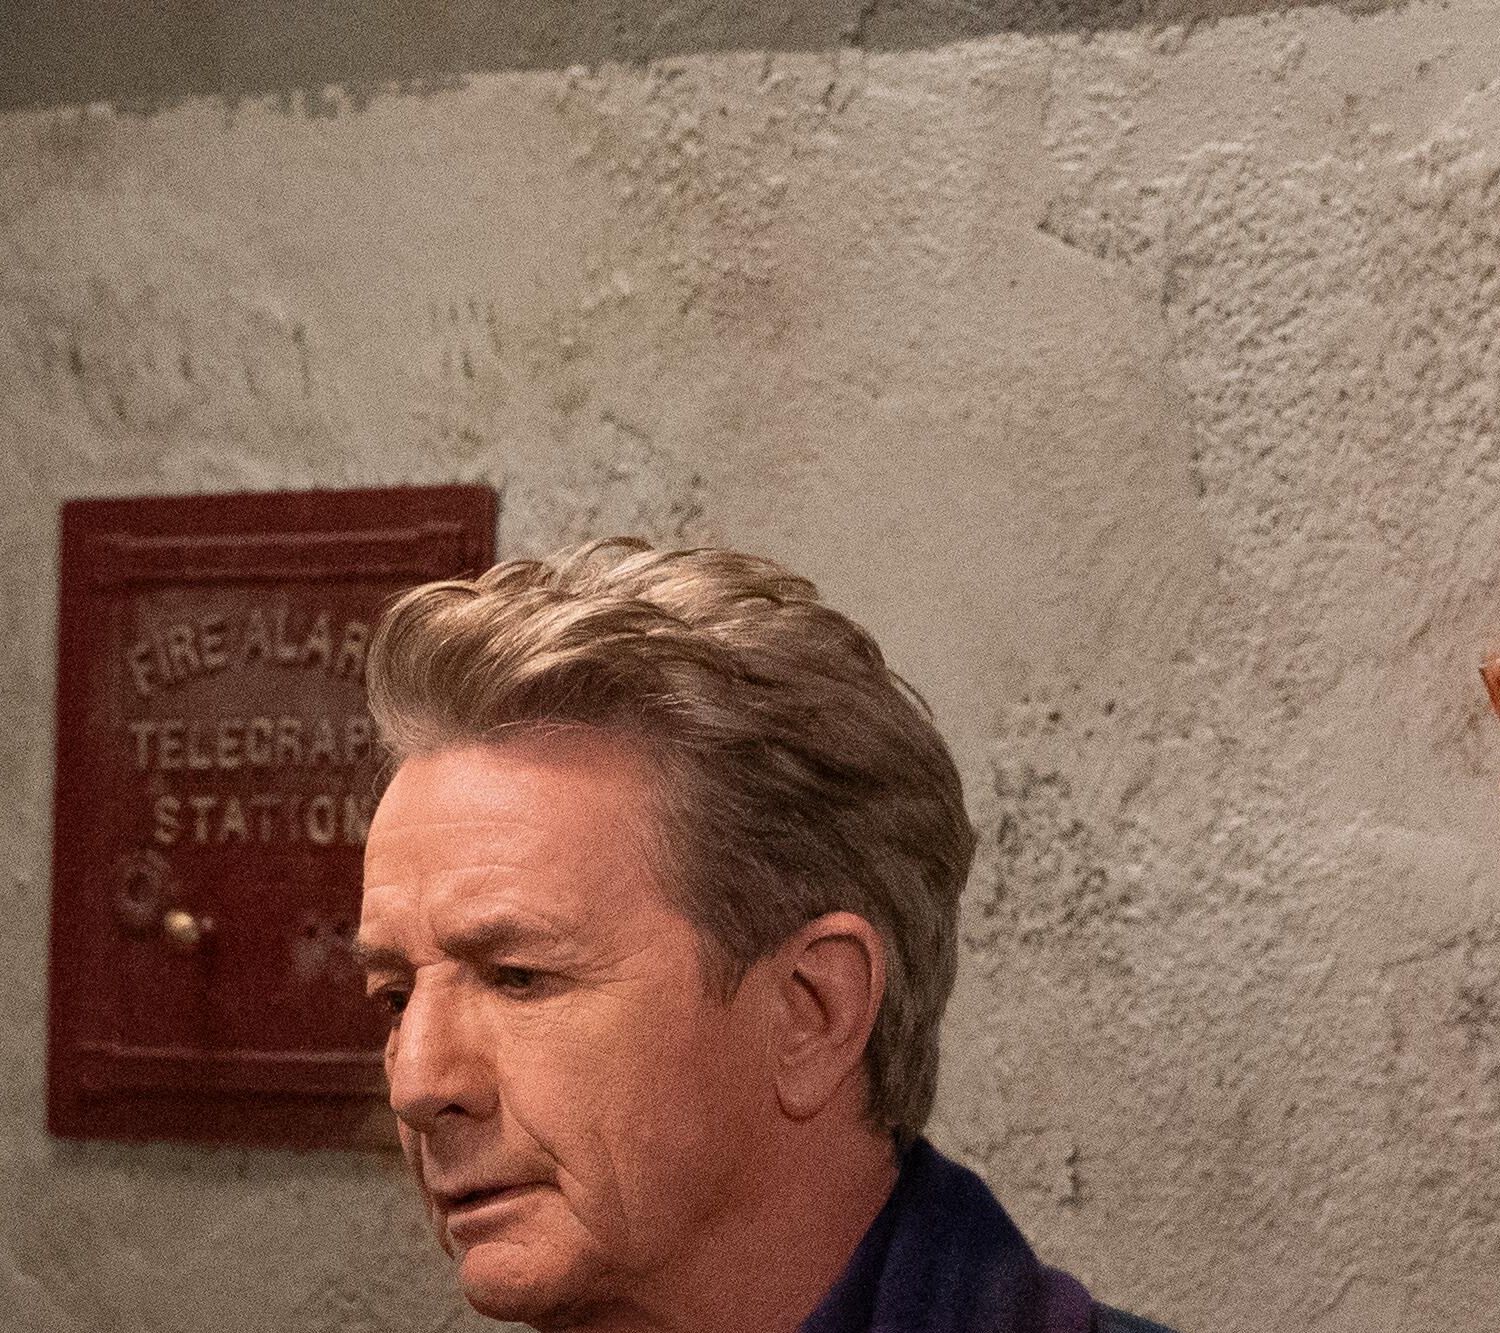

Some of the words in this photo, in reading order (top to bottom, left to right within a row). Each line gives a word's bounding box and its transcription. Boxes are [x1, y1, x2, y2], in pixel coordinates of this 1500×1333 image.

[127, 613, 228, 697] FIRE
[240, 604, 369, 678] ALAR
[128, 715, 382, 769] TELEGRAP
